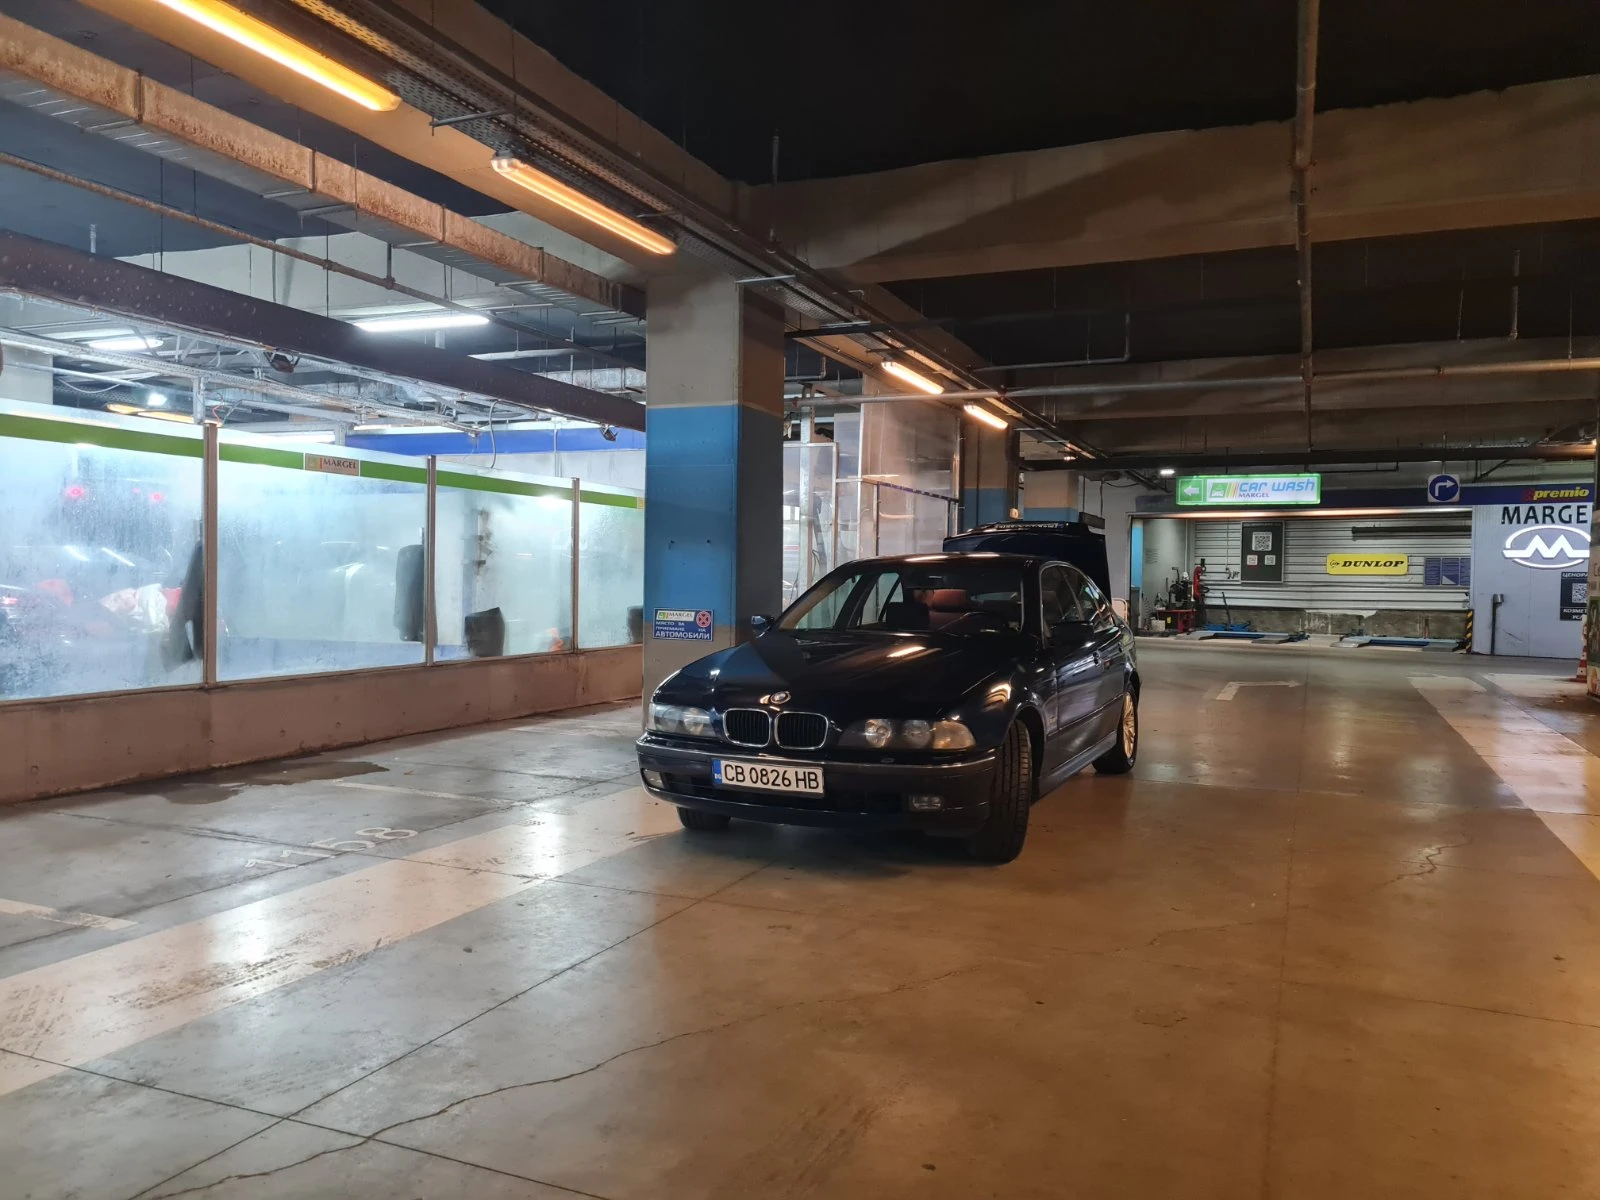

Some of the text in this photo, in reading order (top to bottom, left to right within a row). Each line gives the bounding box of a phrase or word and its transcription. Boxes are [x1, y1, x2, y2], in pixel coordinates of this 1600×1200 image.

[324, 458, 356, 469] MARGEL
[1533, 487, 1590, 500] premio
[1501, 505, 1588, 524] MARGE
[1341, 560, 1404, 568] DUNLOP
[656, 631, 710, 639] АВТОМОБИЛИ
[724, 763, 820, 790] CB 0826 HB
